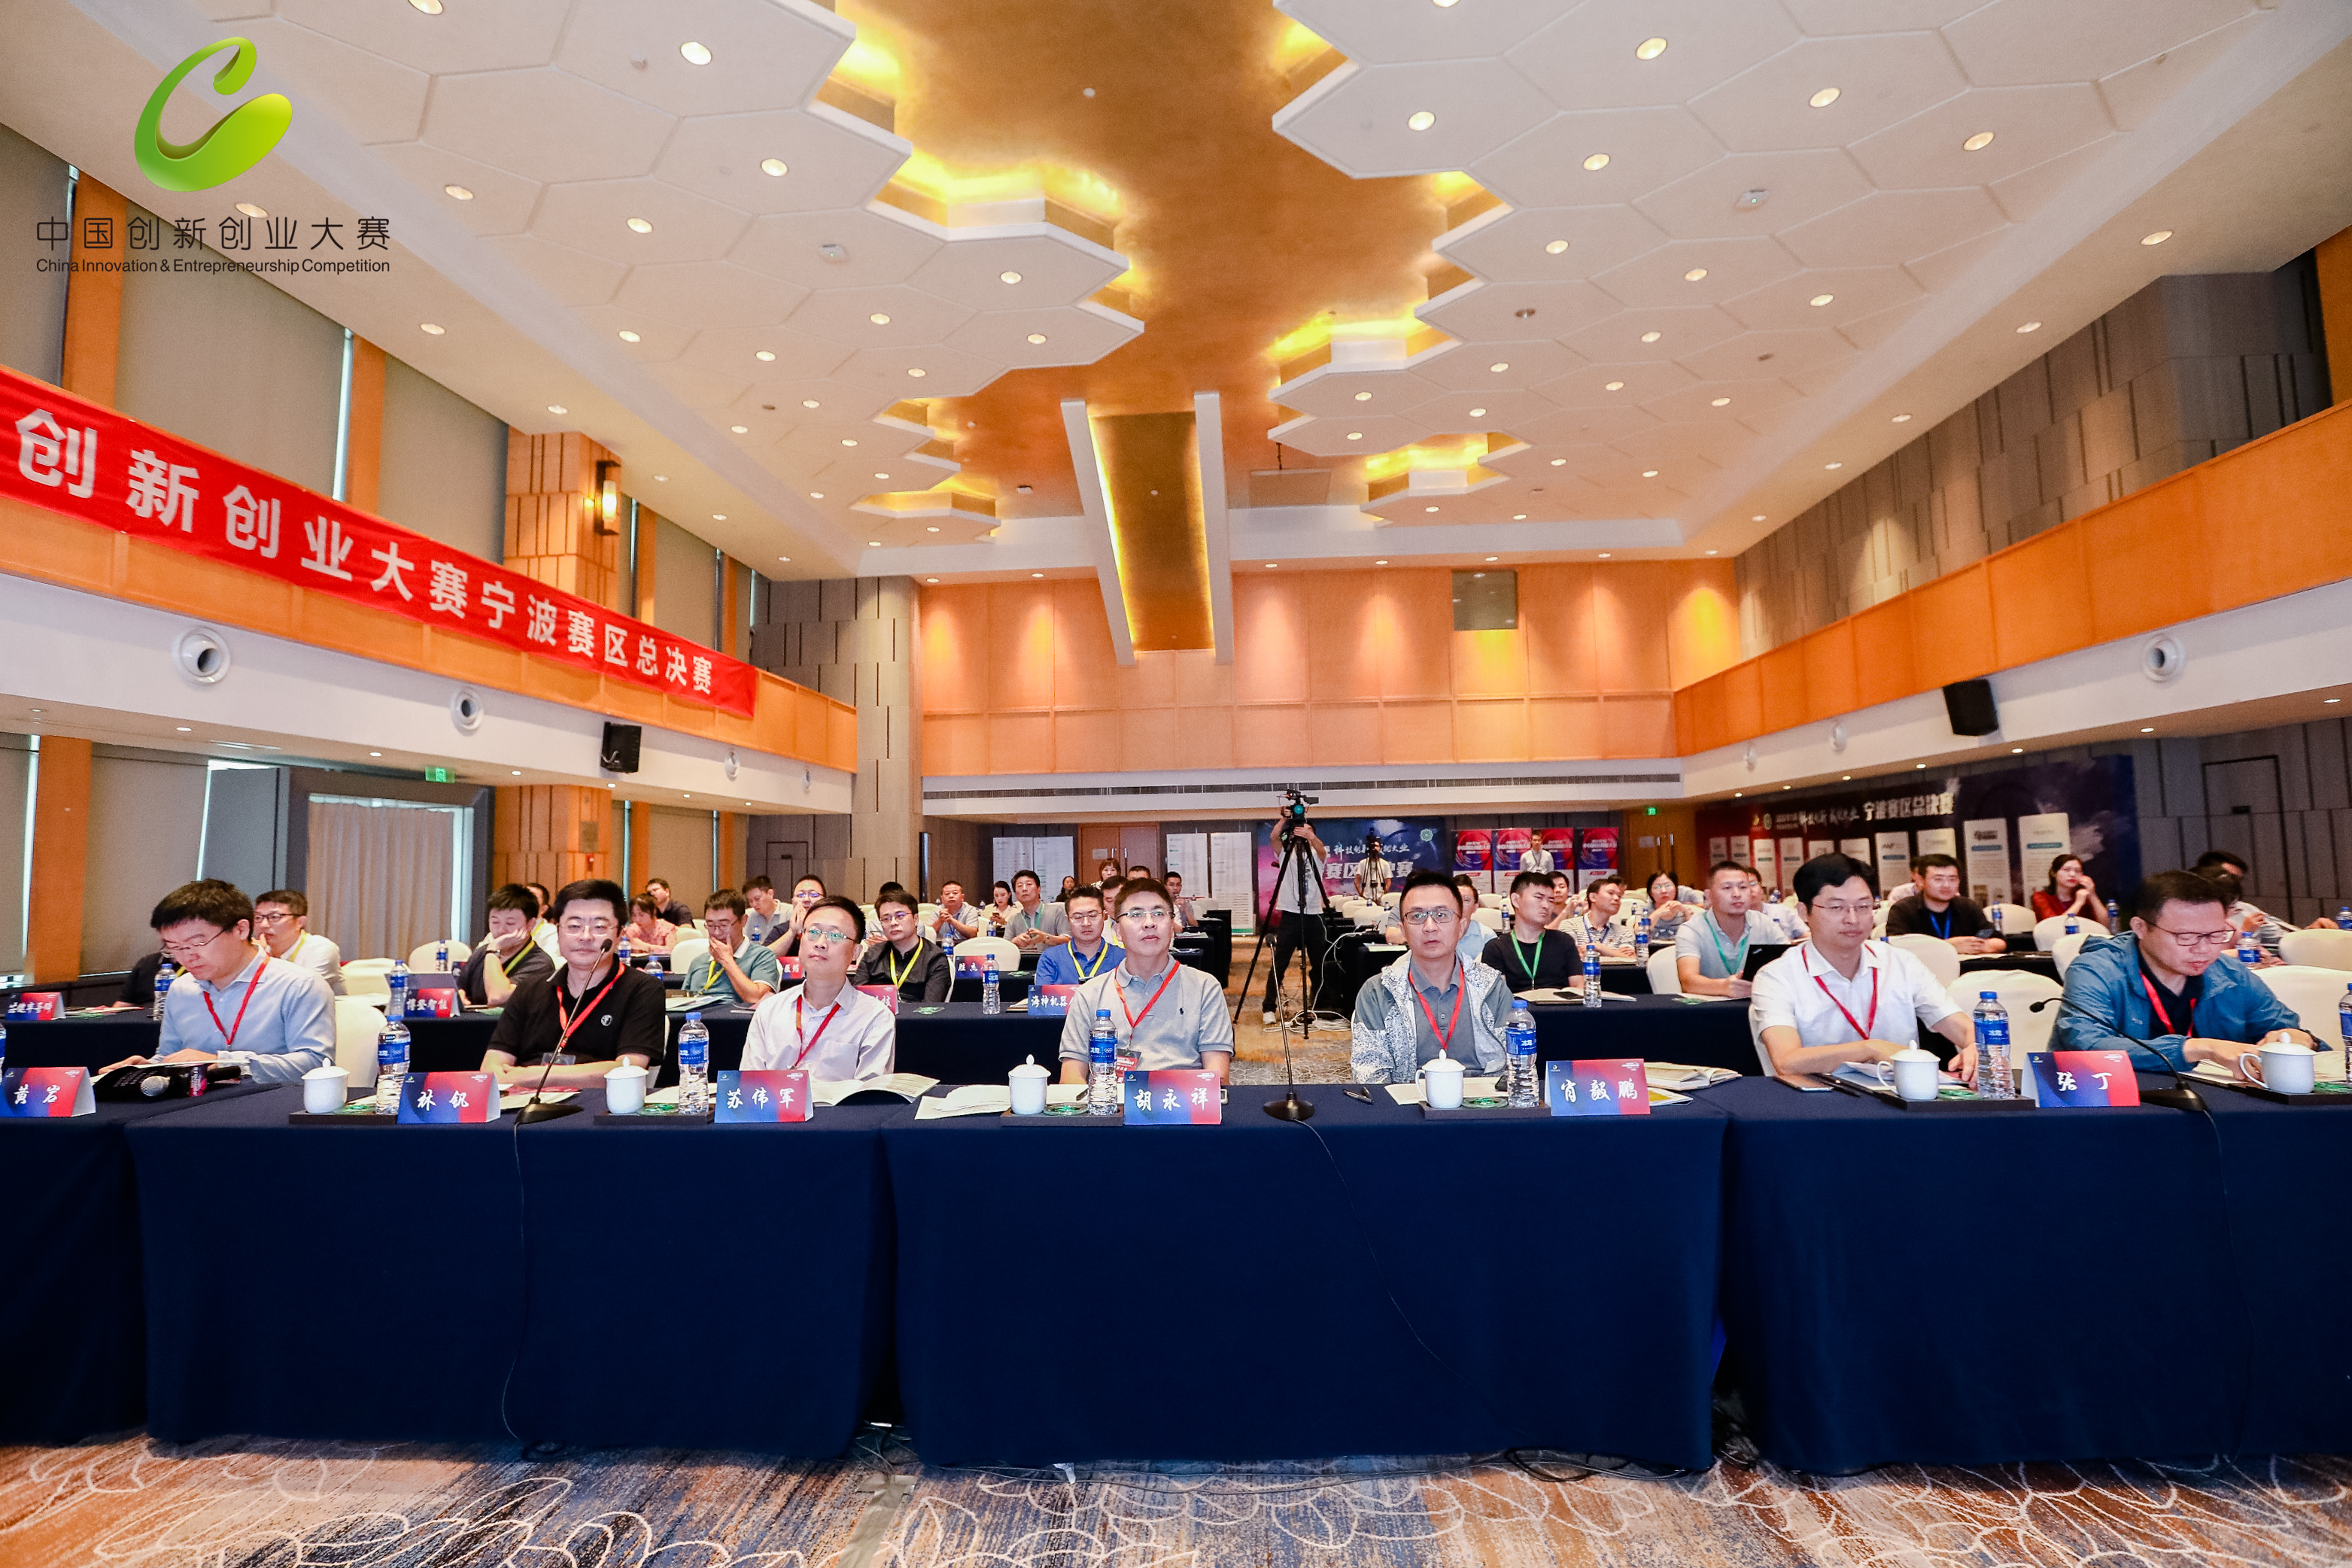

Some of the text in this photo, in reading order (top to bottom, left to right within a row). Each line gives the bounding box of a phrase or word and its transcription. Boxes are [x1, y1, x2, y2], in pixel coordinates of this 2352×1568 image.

[15, 408, 712, 694] 创新创业大赛宁波赛区总决赛
[1031, 995, 1074, 1008] 海神机器
[1560, 1077, 1638, 1103] 肖毅鹏
[2056, 1071, 2113, 1091] 张丁
[14, 1083, 61, 1104] 黄岩
[727, 1086, 795, 1110] 苏伟军
[1133, 1087, 1209, 1111] 胡永祥
